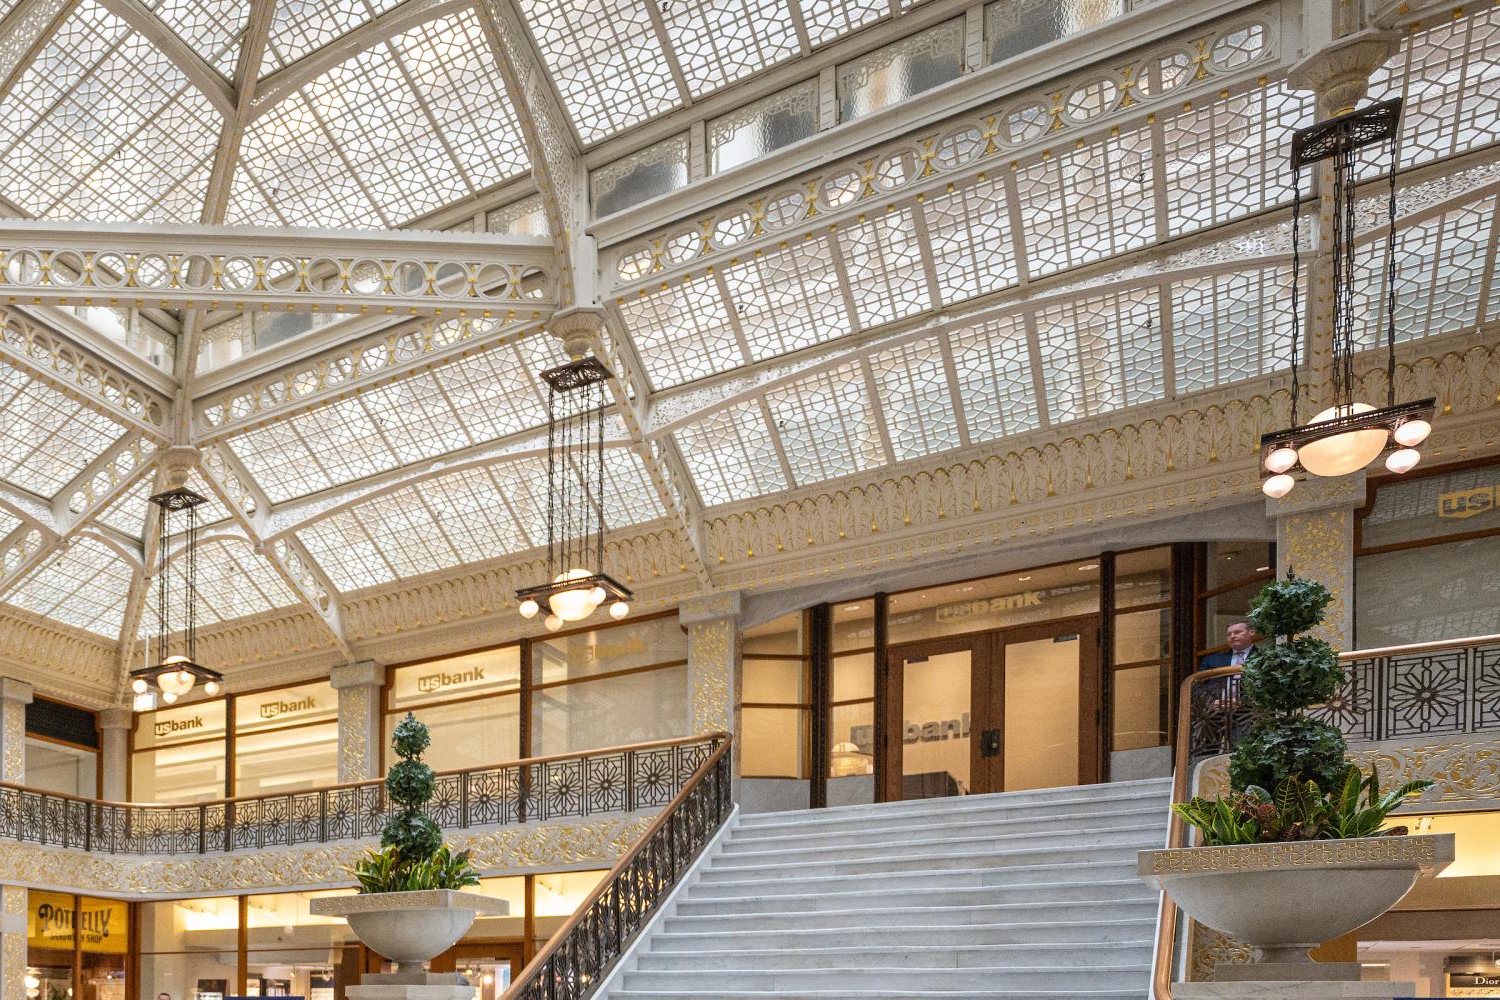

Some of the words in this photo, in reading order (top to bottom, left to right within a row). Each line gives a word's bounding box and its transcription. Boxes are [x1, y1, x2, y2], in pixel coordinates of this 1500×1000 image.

[1439, 486, 1500, 518] us
[419, 667, 485, 692] usbank
[260, 697, 315, 719] usbank
[154, 715, 203, 736] usbank
[1475, 976, 1499, 985] Dior
